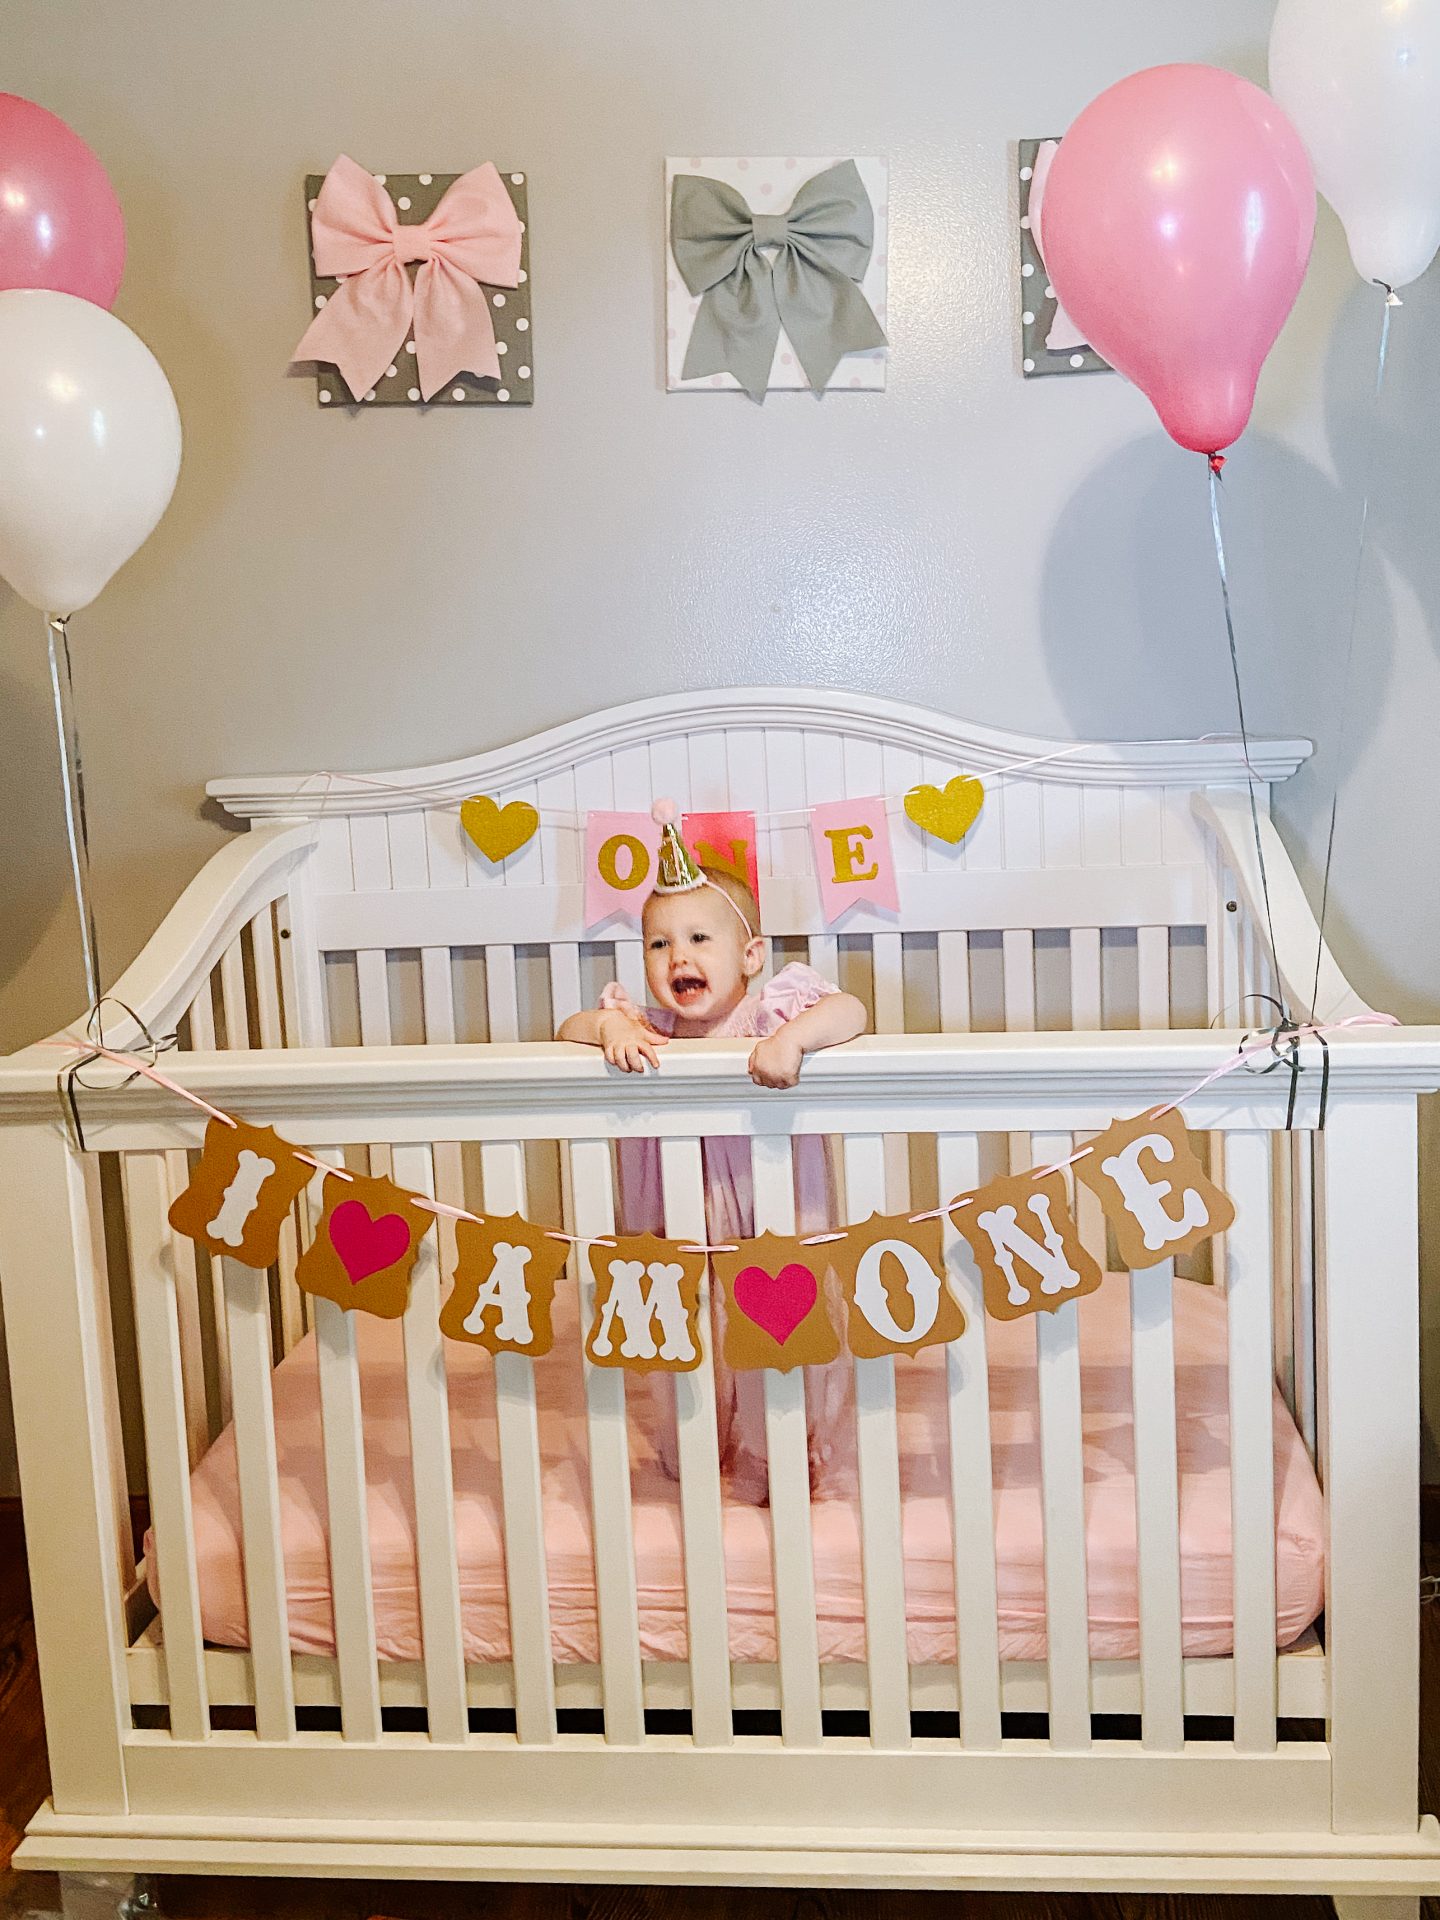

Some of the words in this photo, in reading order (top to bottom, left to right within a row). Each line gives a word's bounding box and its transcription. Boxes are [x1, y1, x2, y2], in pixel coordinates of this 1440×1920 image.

[206, 1149, 276, 1247] I
[462, 1242, 697, 1362] AM
[854, 1133, 1209, 1343] ONE
